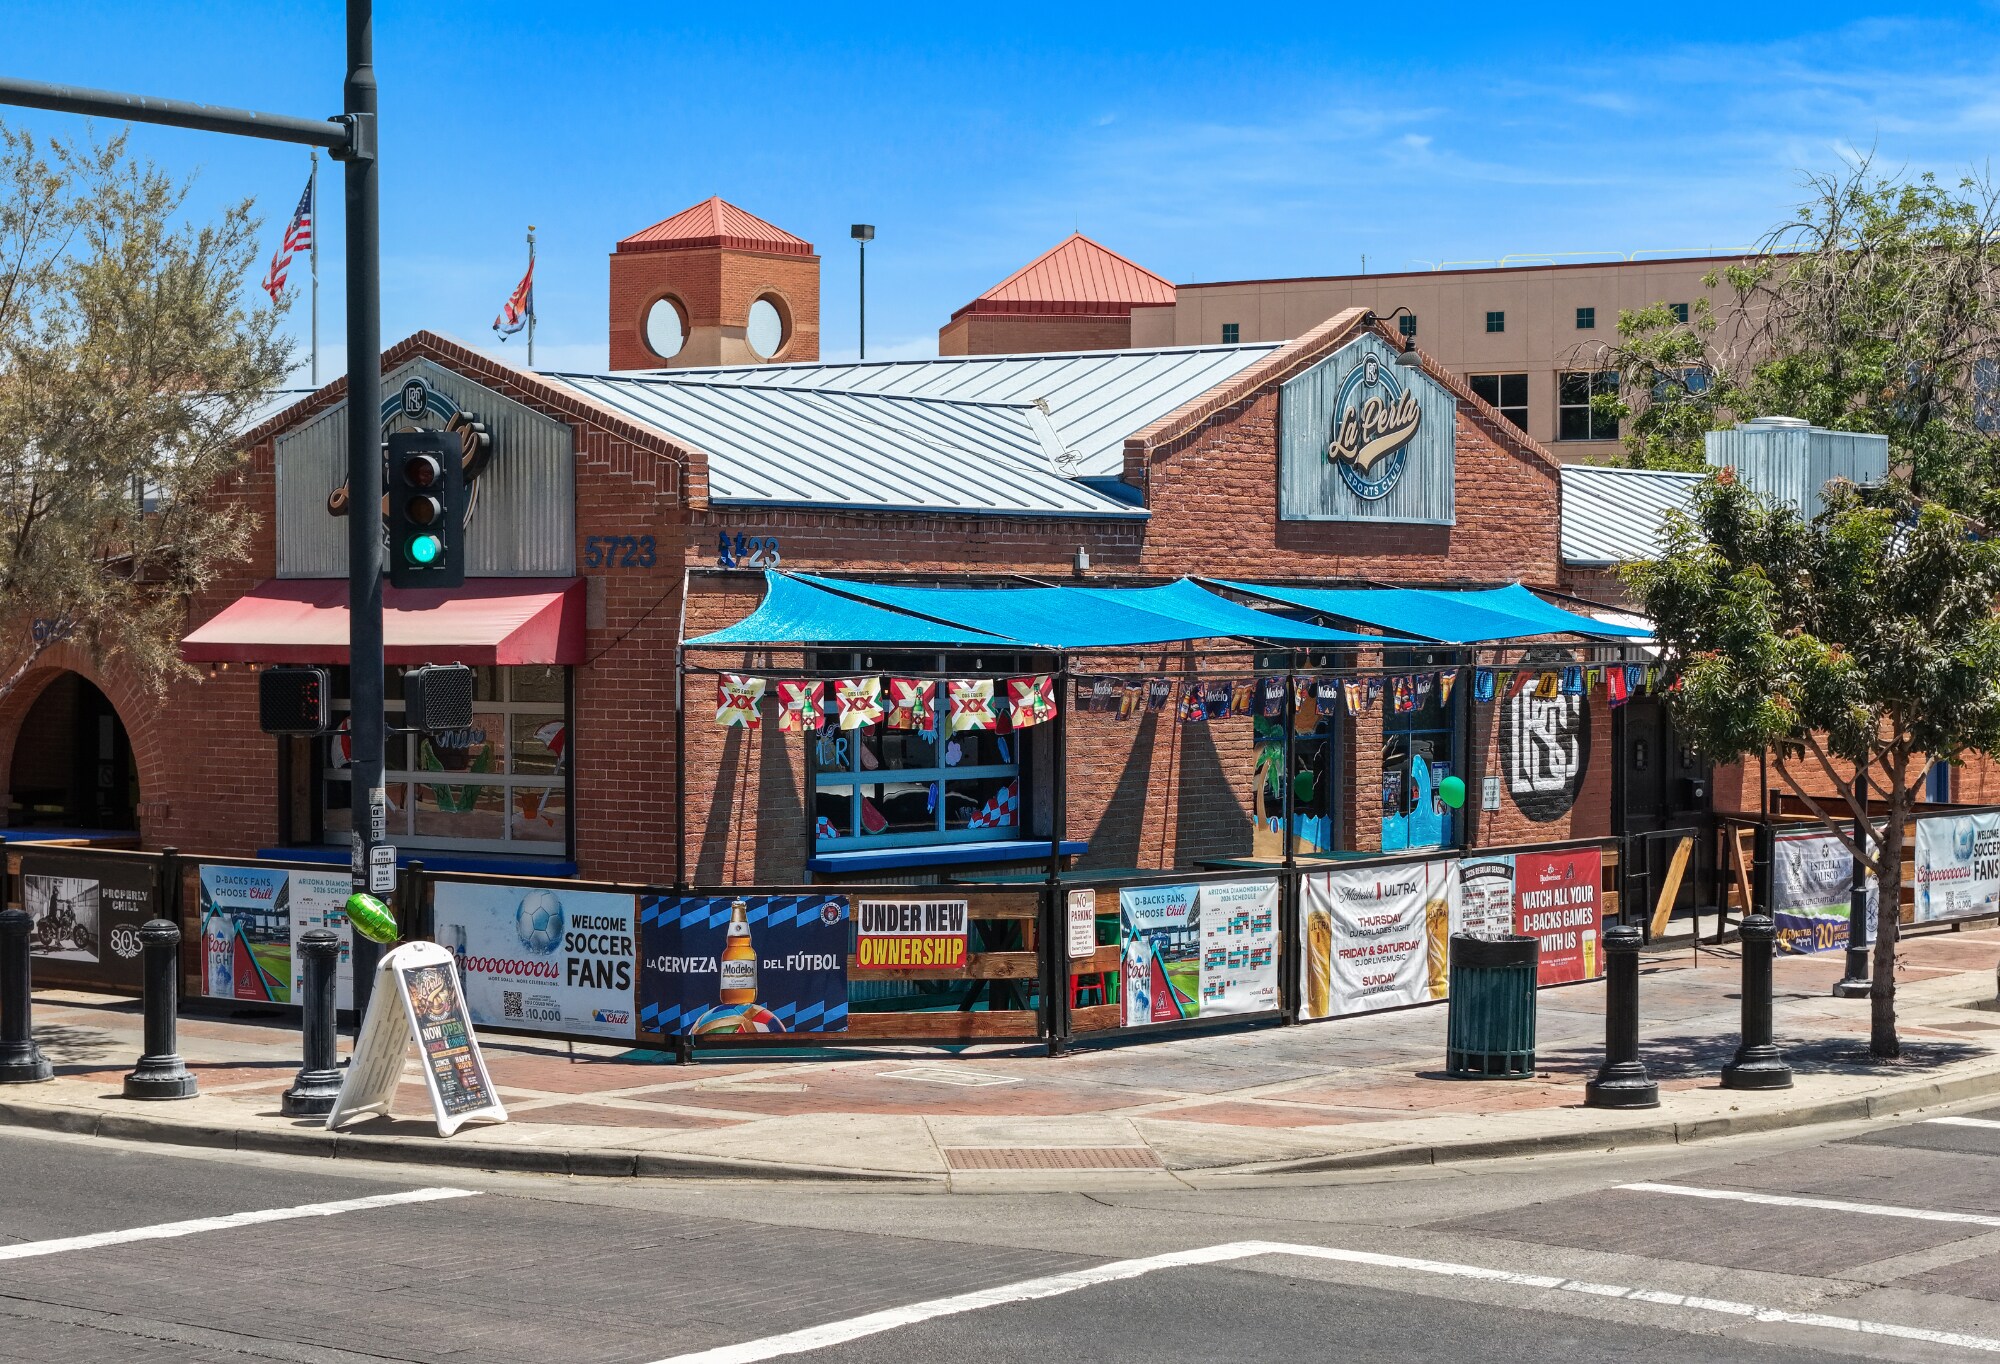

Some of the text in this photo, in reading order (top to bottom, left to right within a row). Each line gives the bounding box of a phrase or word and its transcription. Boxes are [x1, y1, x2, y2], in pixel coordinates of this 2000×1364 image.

[1329, 387, 1421, 459] La Perla
[1347, 462, 1402, 496] SPORTS CLUB
[584, 534, 657, 568] 5723
[1206, 690, 1228, 703] Modelo
[1265, 687, 1285, 700] Modelo
[1318, 686, 1338, 699] Modelo
[726, 693, 756, 711] XX
[846, 695, 875, 712] XX
[959, 698, 987, 713] XX
[1976, 828, 1999, 841] WELCOME
[1475, 865, 1491, 875] REGULAR
[1491, 865, 1506, 874] SEASON
[1810, 860, 1841, 871] ESTRELLA
[1973, 858, 1999, 881] FANS
[215, 874, 273, 888] D-BACKS FANS,
[298, 878, 324, 886] ARIZONA
[1814, 870, 1838, 882] JALISCO
[102, 888, 148, 901] PROPERLY
[215, 886, 273, 900] CHOOSE Chill
[313, 886, 326, 894] 2026
[1208, 885, 1269, 896] ARIZONA DIAMONDBACKS
[1232, 893, 1257, 901] SCHEDULE
[1339, 882, 1418, 904] Michelob ULTRA
[1076, 895, 1087, 908] NO
[1135, 894, 1187, 906] D-BACKS FANS,
[1522, 885, 1594, 910] WATCH ALL YOUR
[111, 900, 139, 911] CHILL
[1135, 903, 1188, 918] CHOOSE Chill
[861, 903, 922, 932] UNDER
[925, 903, 964, 932] NEW
[1070, 909, 1093, 922] PARKING
[1357, 913, 1402, 928] THURSDAY
[1523, 907, 1593, 932] D-BACKS GAMES
[571, 914, 627, 932] WELCOME
[1349, 924, 1410, 938] DJ FOR LADIES NIGHT
[1815, 922, 1834, 949] $20
[110, 929, 144, 953] 805
[564, 932, 634, 957] SOCCER
[1540, 931, 1576, 953] WITH US
[859, 937, 964, 965] OWNERSHIP
[1339, 940, 1420, 960] FRIDAY & SATURDAY
[646, 955, 718, 973] LA CERVEZA
[763, 951, 841, 971] DEL FÚTBOL
[1355, 959, 1363, 967] DJ
[1372, 956, 1386, 965] LIVE
[1386, 953, 1406, 962] MUSIC
[567, 957, 632, 991] FANS
[725, 963, 751, 975] Modelo
[1362, 972, 1397, 987] SUNDAY
[1362, 984, 1396, 995] LIVE MUSIC
[525, 1008, 561, 1022] $10,000
[605, 1012, 630, 1025] Chill
[421, 1025, 442, 1041] NOW
[441, 1021, 465, 1037] OPEN
[434, 1058, 450, 1067] LUNCH
[455, 1053, 471, 1063] HAPPY
